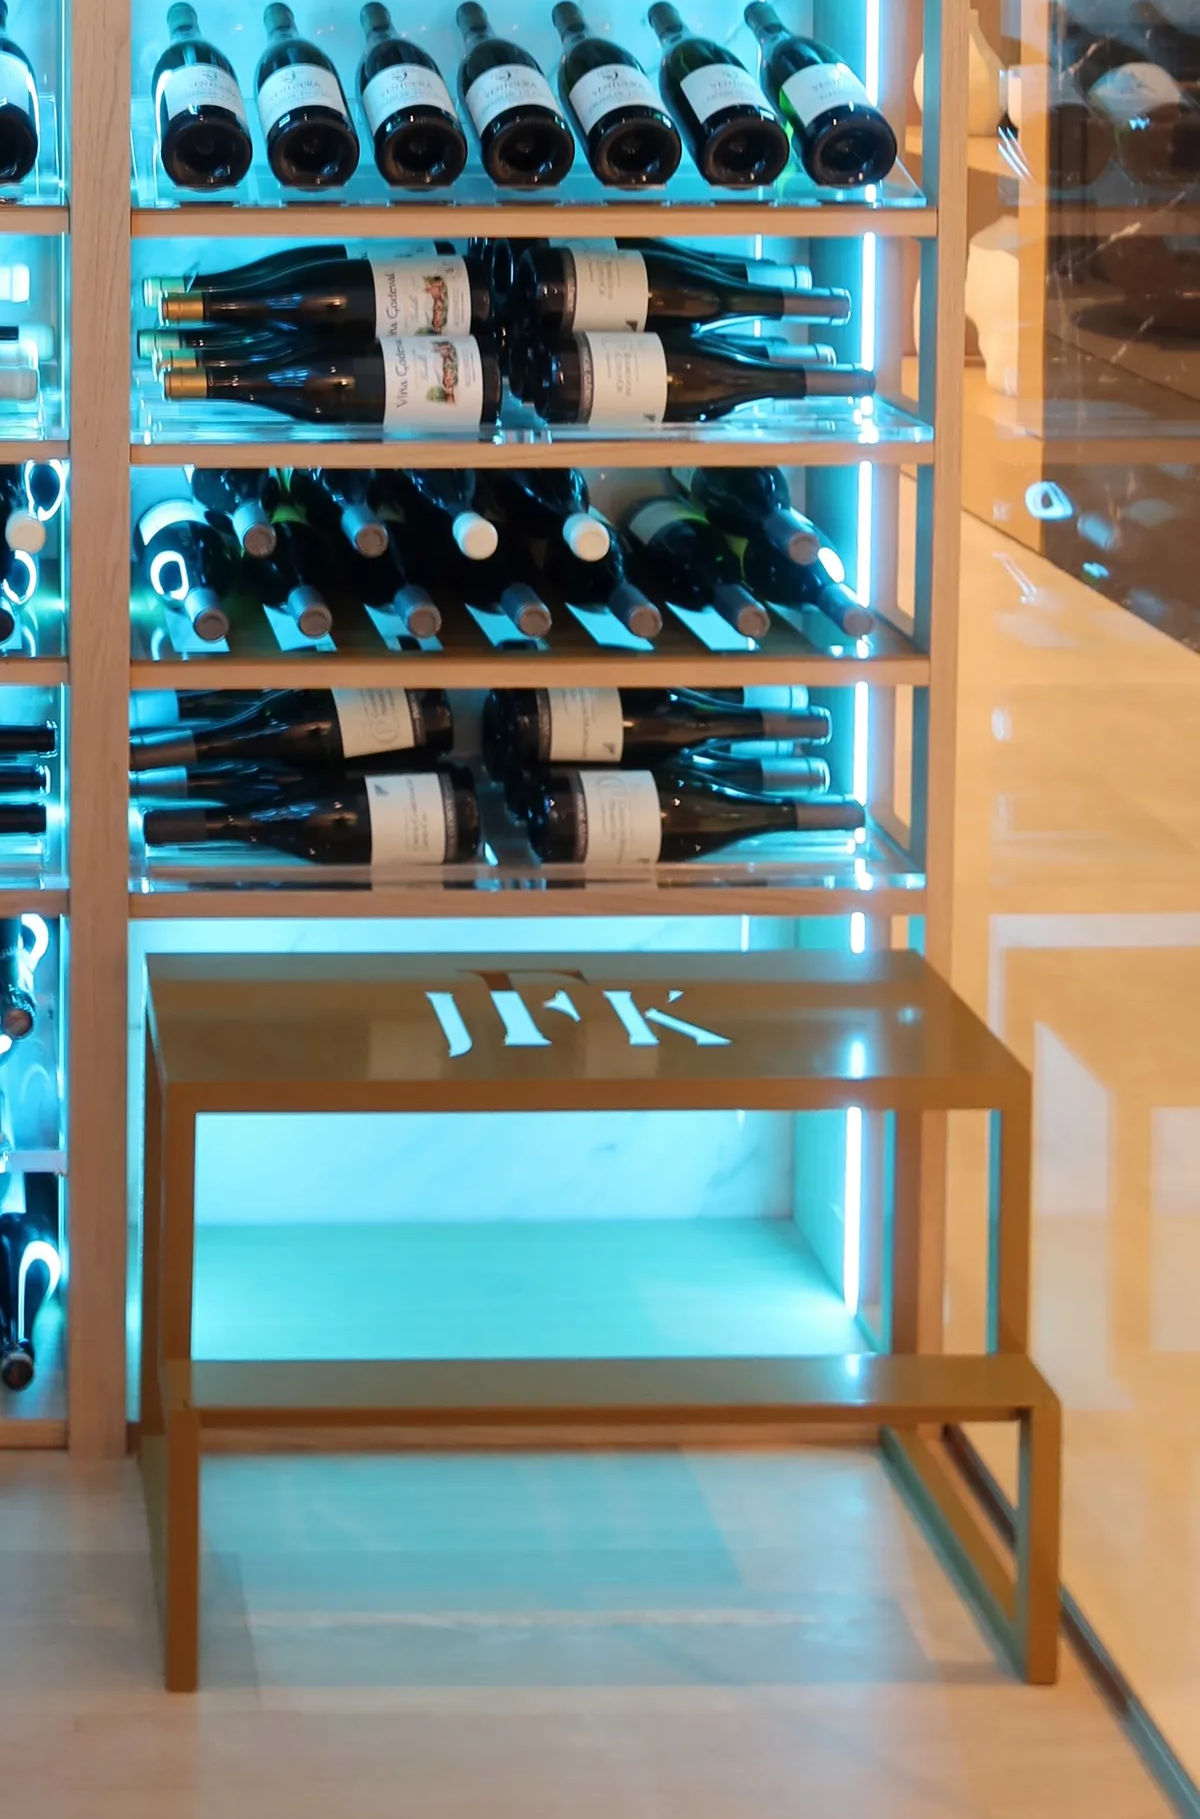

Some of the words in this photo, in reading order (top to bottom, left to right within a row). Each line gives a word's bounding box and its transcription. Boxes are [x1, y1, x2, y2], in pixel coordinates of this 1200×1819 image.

[385, 271, 401, 320] Godeval
[392, 336, 410, 377] Godeva
[425, 969, 732, 1058] JFK
